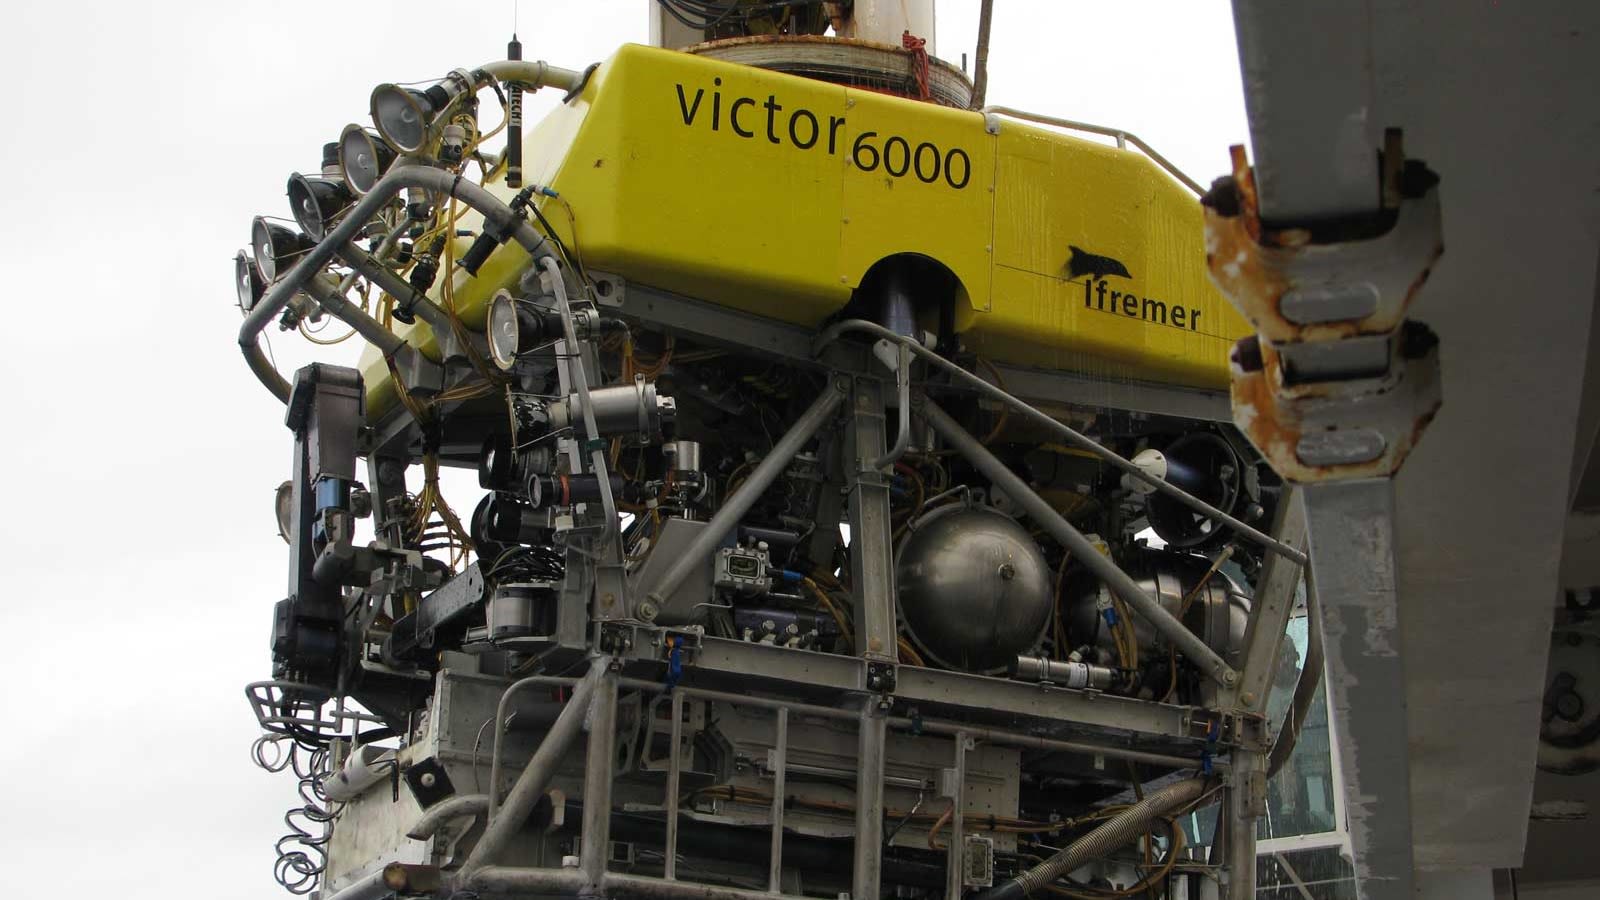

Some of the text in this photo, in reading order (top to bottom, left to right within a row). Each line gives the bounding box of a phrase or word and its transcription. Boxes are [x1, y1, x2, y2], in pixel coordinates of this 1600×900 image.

[676, 77, 971, 189] victor 6000
[1085, 279, 1201, 330] Ifremer
